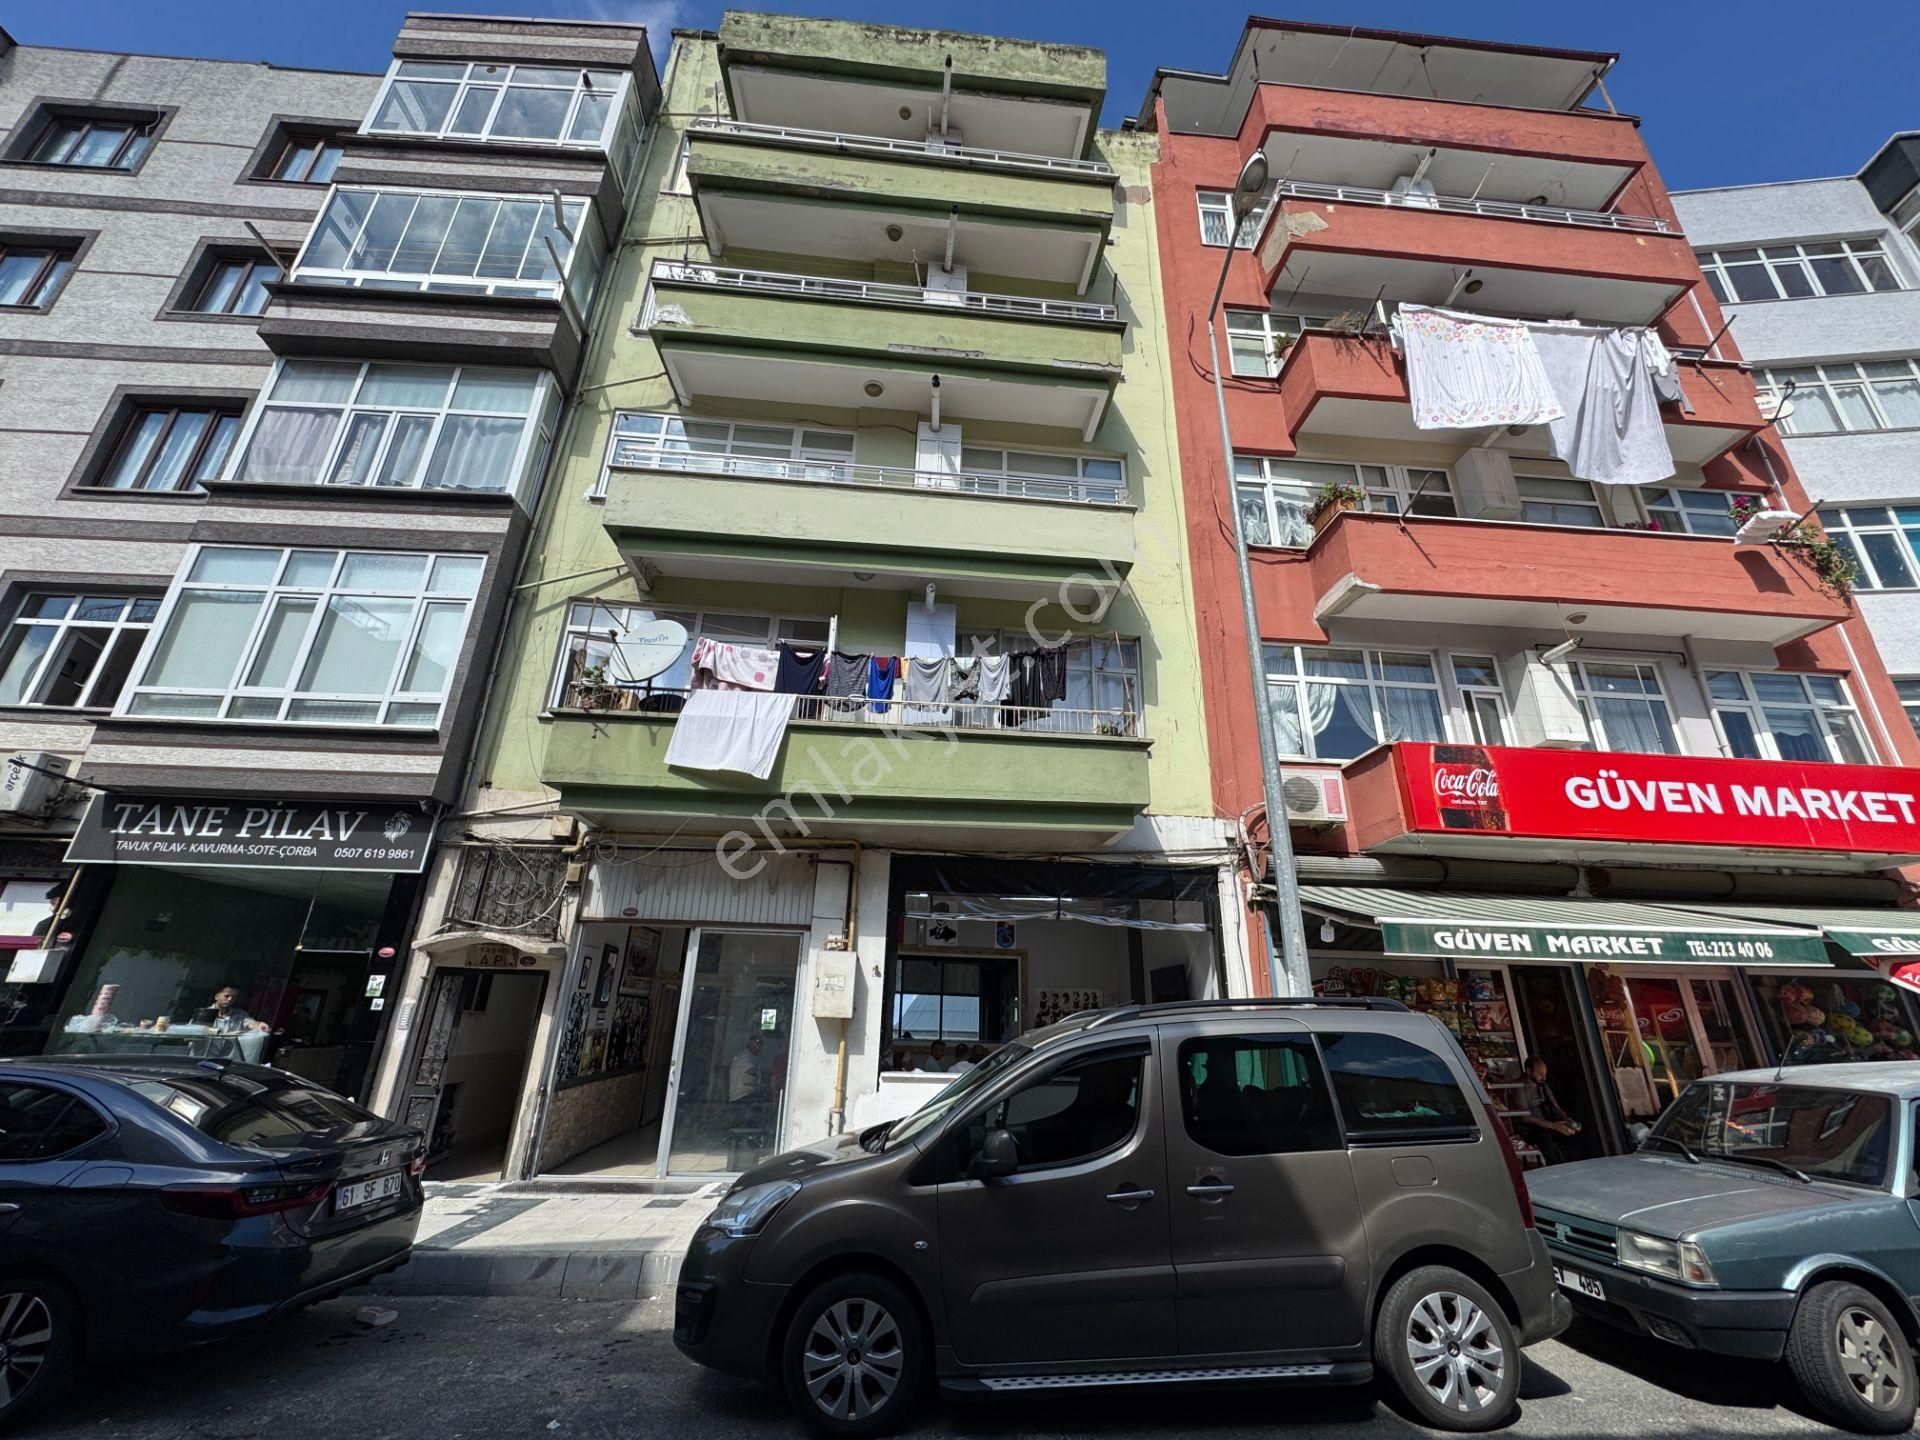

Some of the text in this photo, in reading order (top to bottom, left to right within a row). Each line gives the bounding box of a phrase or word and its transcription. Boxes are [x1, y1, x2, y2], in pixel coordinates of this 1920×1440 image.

[5, 754, 26, 791] arçek
[1435, 768, 1499, 797] Coca-Cola
[1565, 769, 1916, 824] GÜVEN MARKET
[110, 801, 368, 841] TANE PİLAV
[116, 840, 152, 851] TAVUK
[189, 843, 317, 858] KAVURMA-SOTE-ÇORBA
[334, 848, 362, 858] 0507
[364, 848, 385, 859] 619
[387, 849, 415, 859] 9861
[1434, 928, 1773, 958] GÜVEN MARKET TEL:223 40 06
[342, 1174, 400, 1206] 61 SF 870
